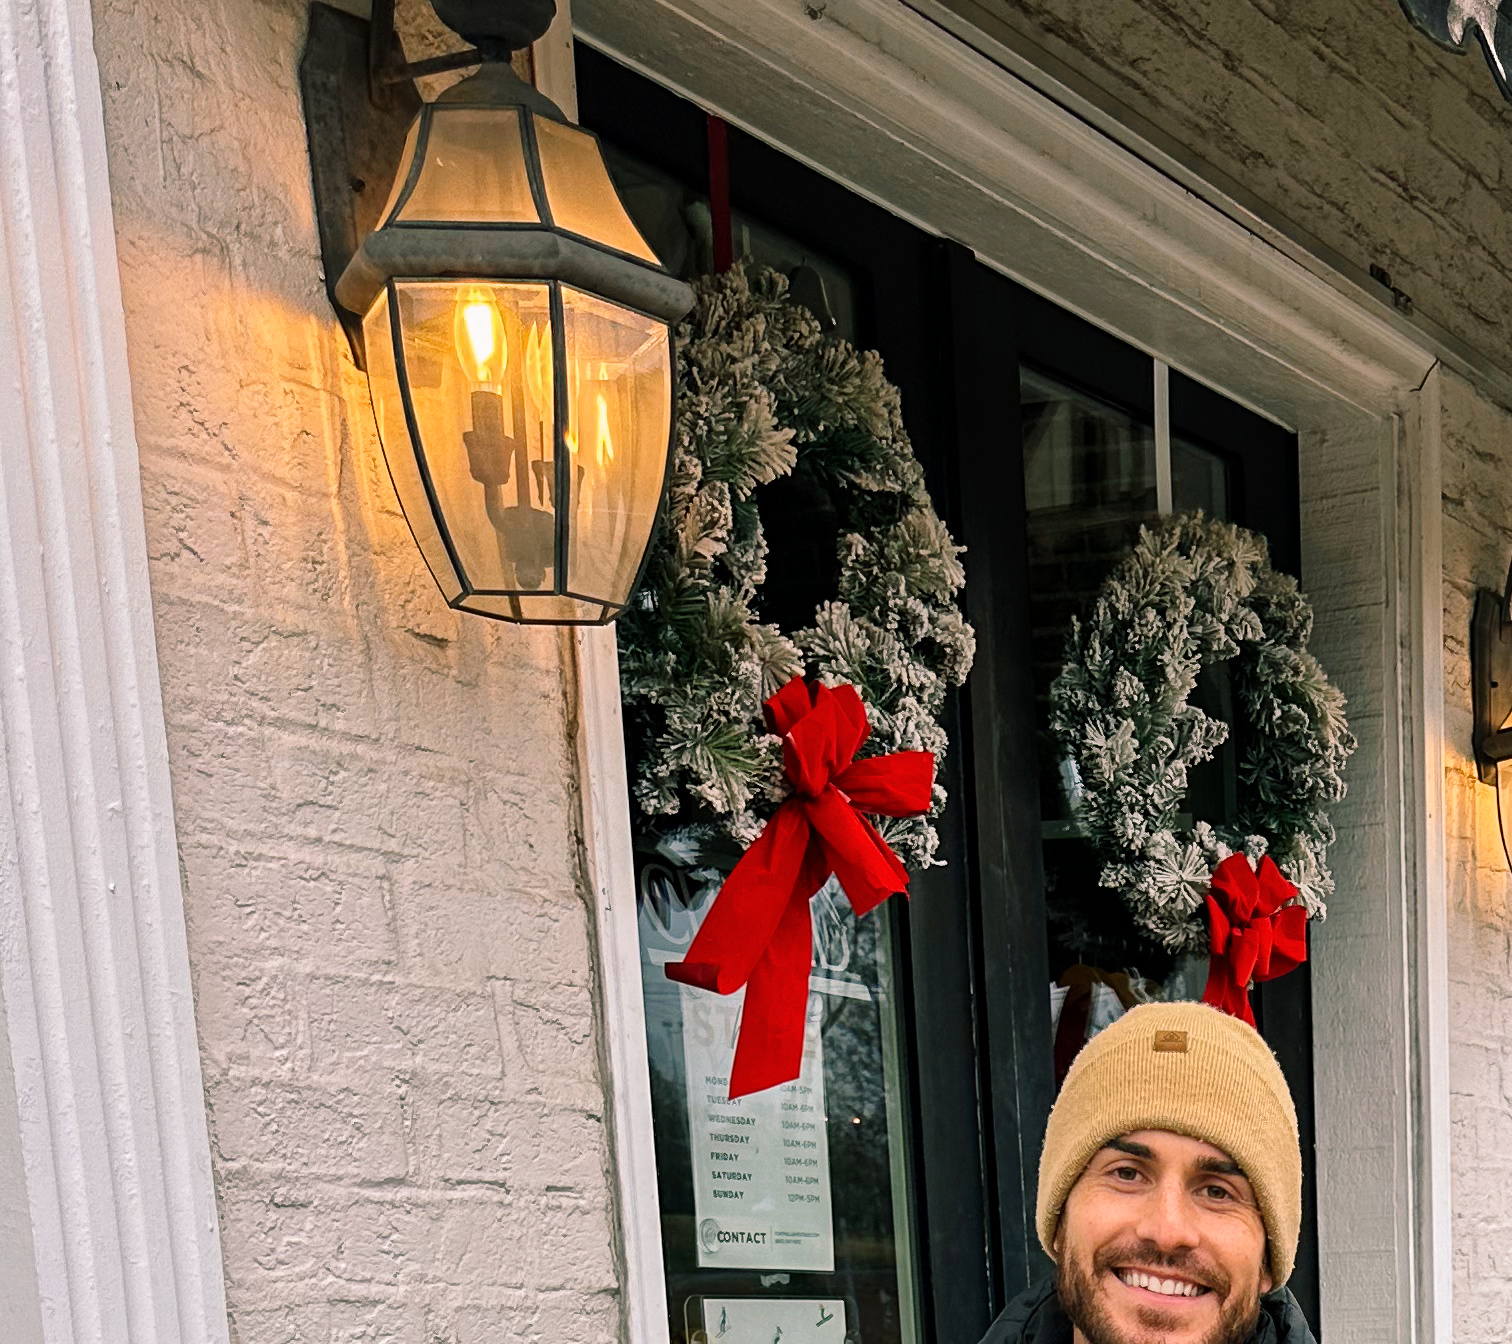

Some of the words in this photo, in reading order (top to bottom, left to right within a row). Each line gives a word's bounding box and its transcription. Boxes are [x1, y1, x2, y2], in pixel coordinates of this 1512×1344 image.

[705, 1076, 729, 1086] MOND
[708, 1114, 756, 1126] WEDNESDAY
[709, 1132, 750, 1144] THURSDAY
[710, 1151, 739, 1161] FRIDAY
[711, 1170, 752, 1181] SATURDAY
[713, 1189, 744, 1200] SUNDAY
[716, 1230, 767, 1245] CONTACT
